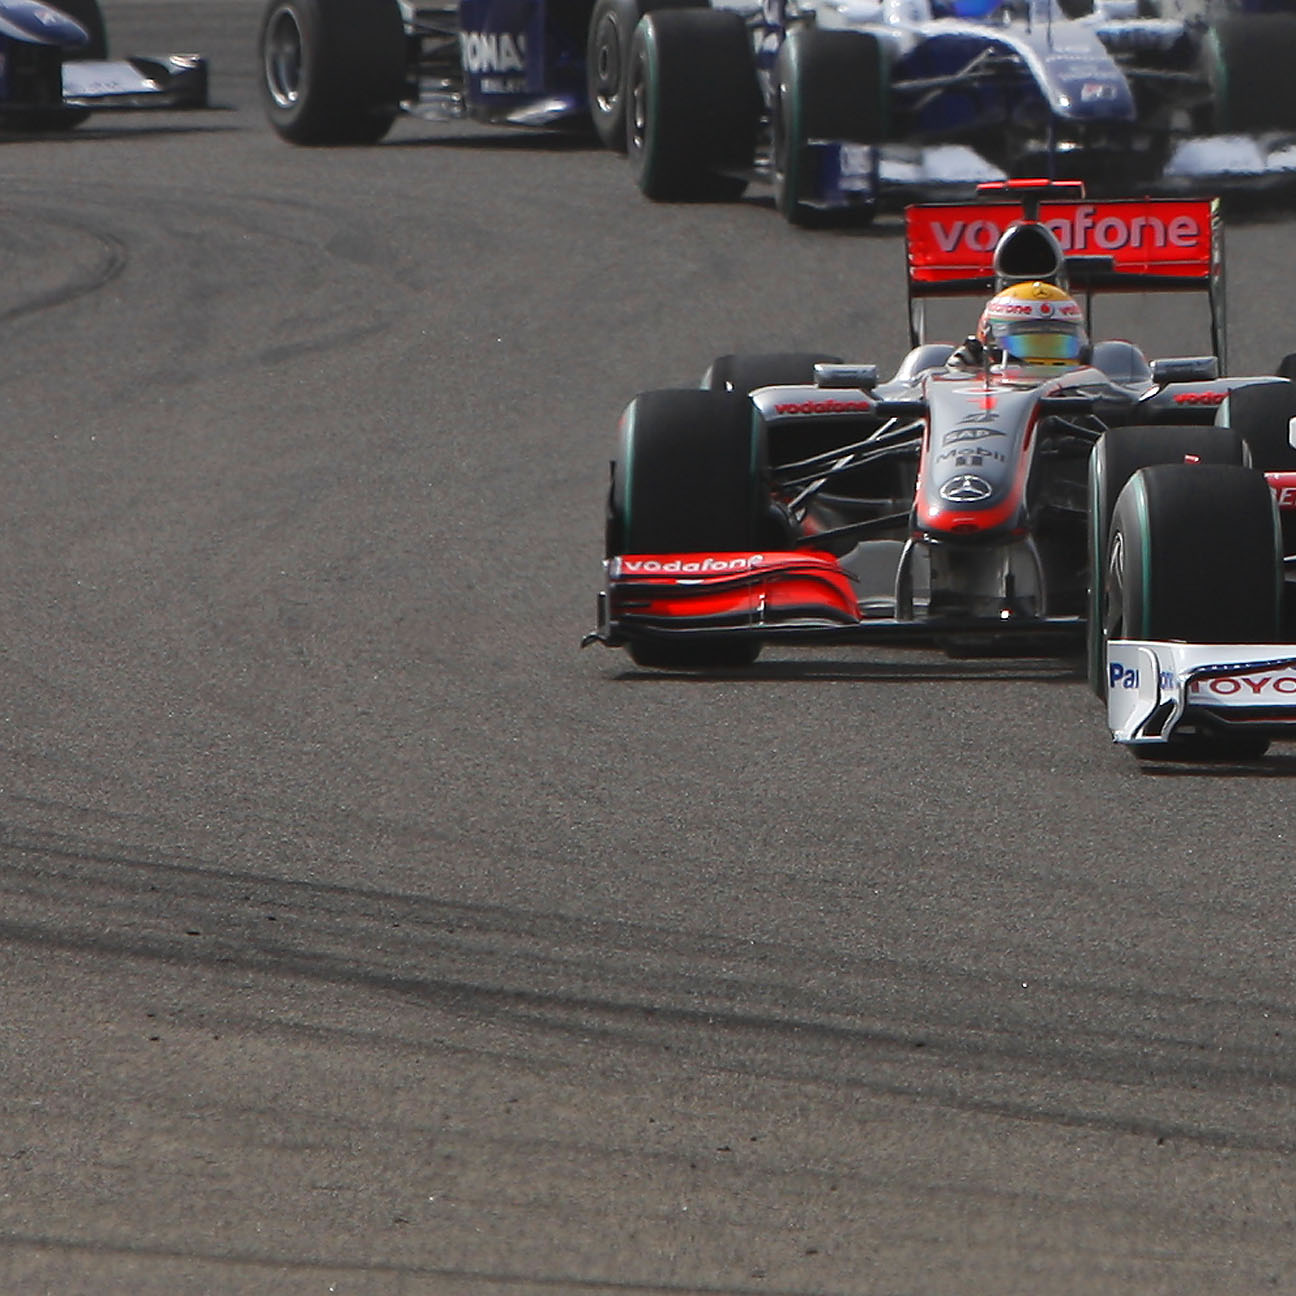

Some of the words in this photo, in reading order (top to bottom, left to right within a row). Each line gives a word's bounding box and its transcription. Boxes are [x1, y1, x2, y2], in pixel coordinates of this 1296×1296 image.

[931, 207, 1200, 252] voafone
[775, 399, 870, 414] vodafone
[624, 554, 765, 573] vodafone
